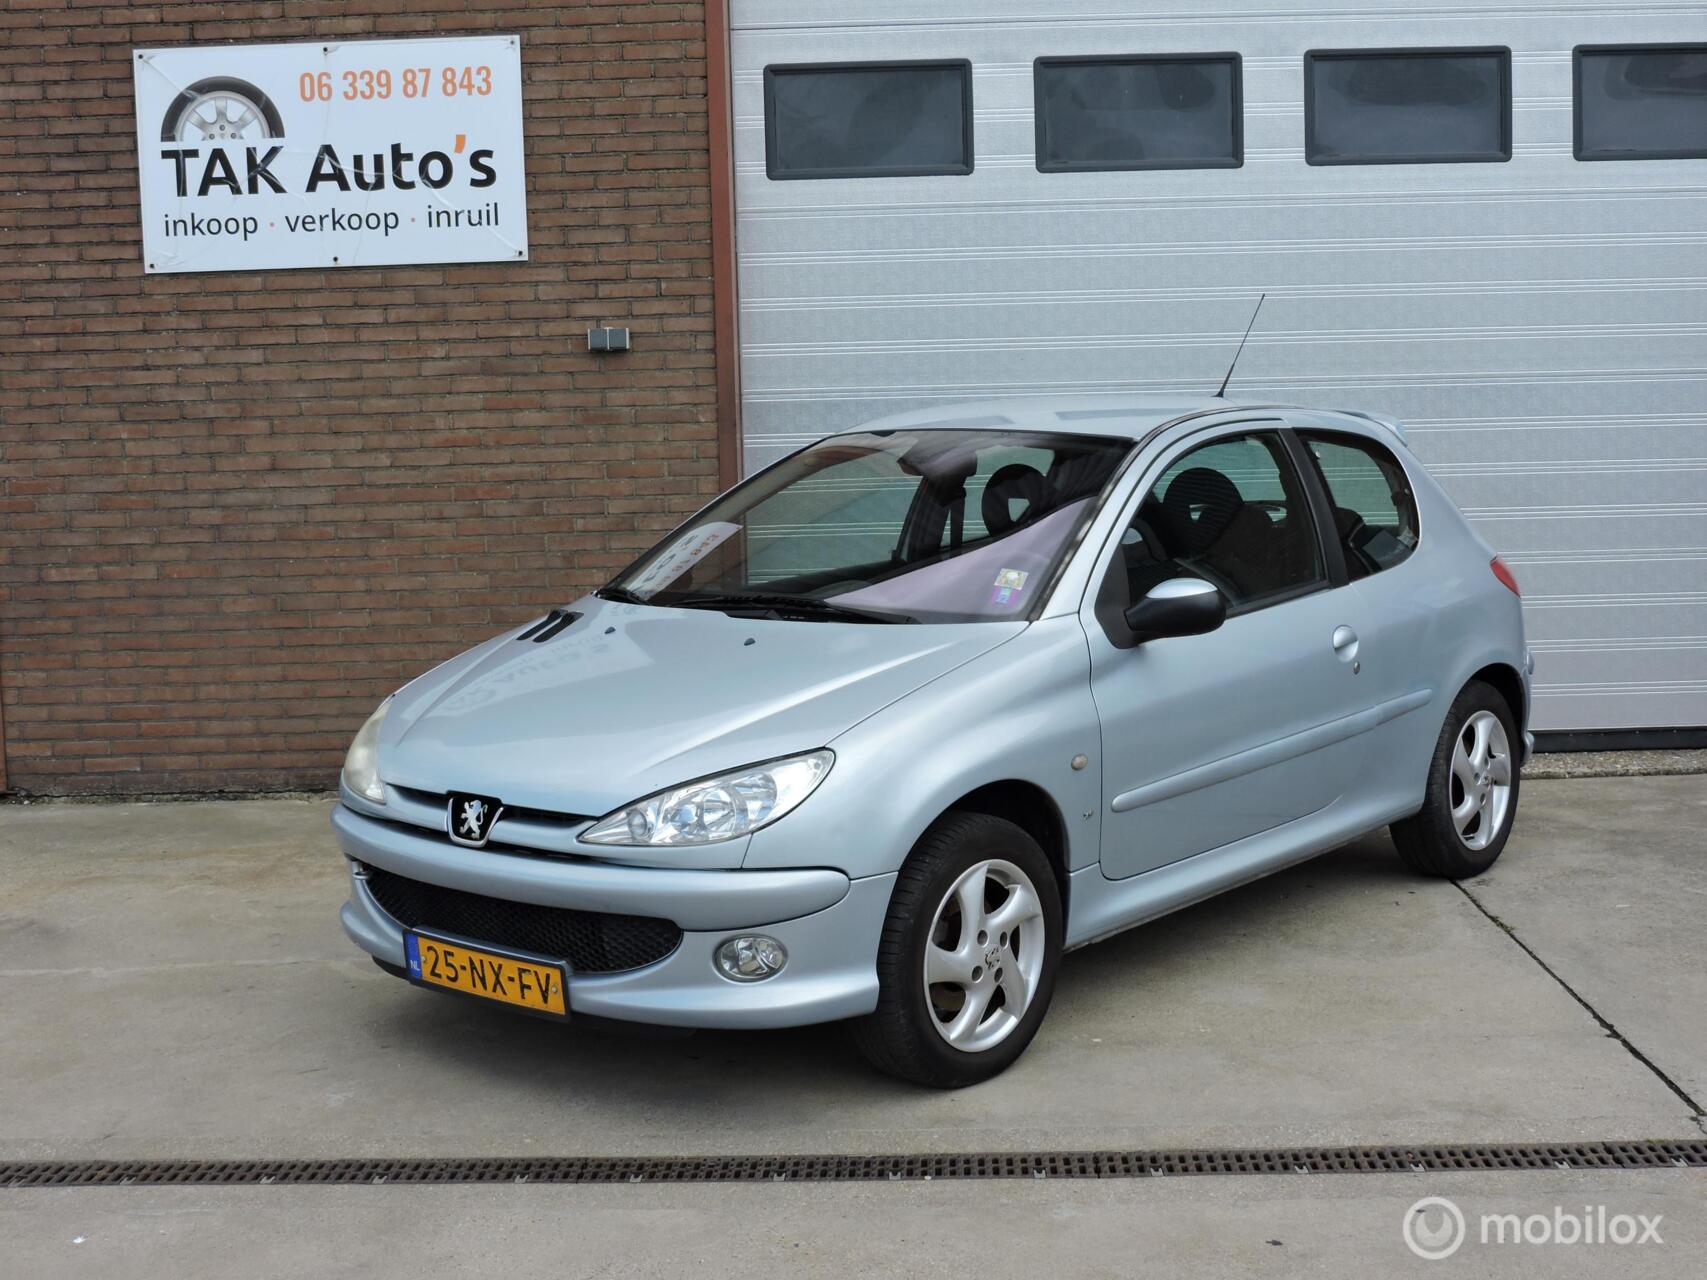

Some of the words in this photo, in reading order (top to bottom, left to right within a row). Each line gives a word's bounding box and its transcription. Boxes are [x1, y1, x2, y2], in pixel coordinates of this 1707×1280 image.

[298, 71, 333, 103] 06
[342, 68, 393, 101] 339
[402, 67, 432, 98] 87
[441, 65, 493, 97] 843
[161, 146, 287, 197] TAK
[305, 134, 497, 192] Auto's
[164, 213, 258, 241] inkoop
[285, 207, 399, 235] verkoop
[427, 202, 499, 228] inruil
[410, 959, 420, 971] NL
[427, 945, 550, 1004] 25-NX-FV
